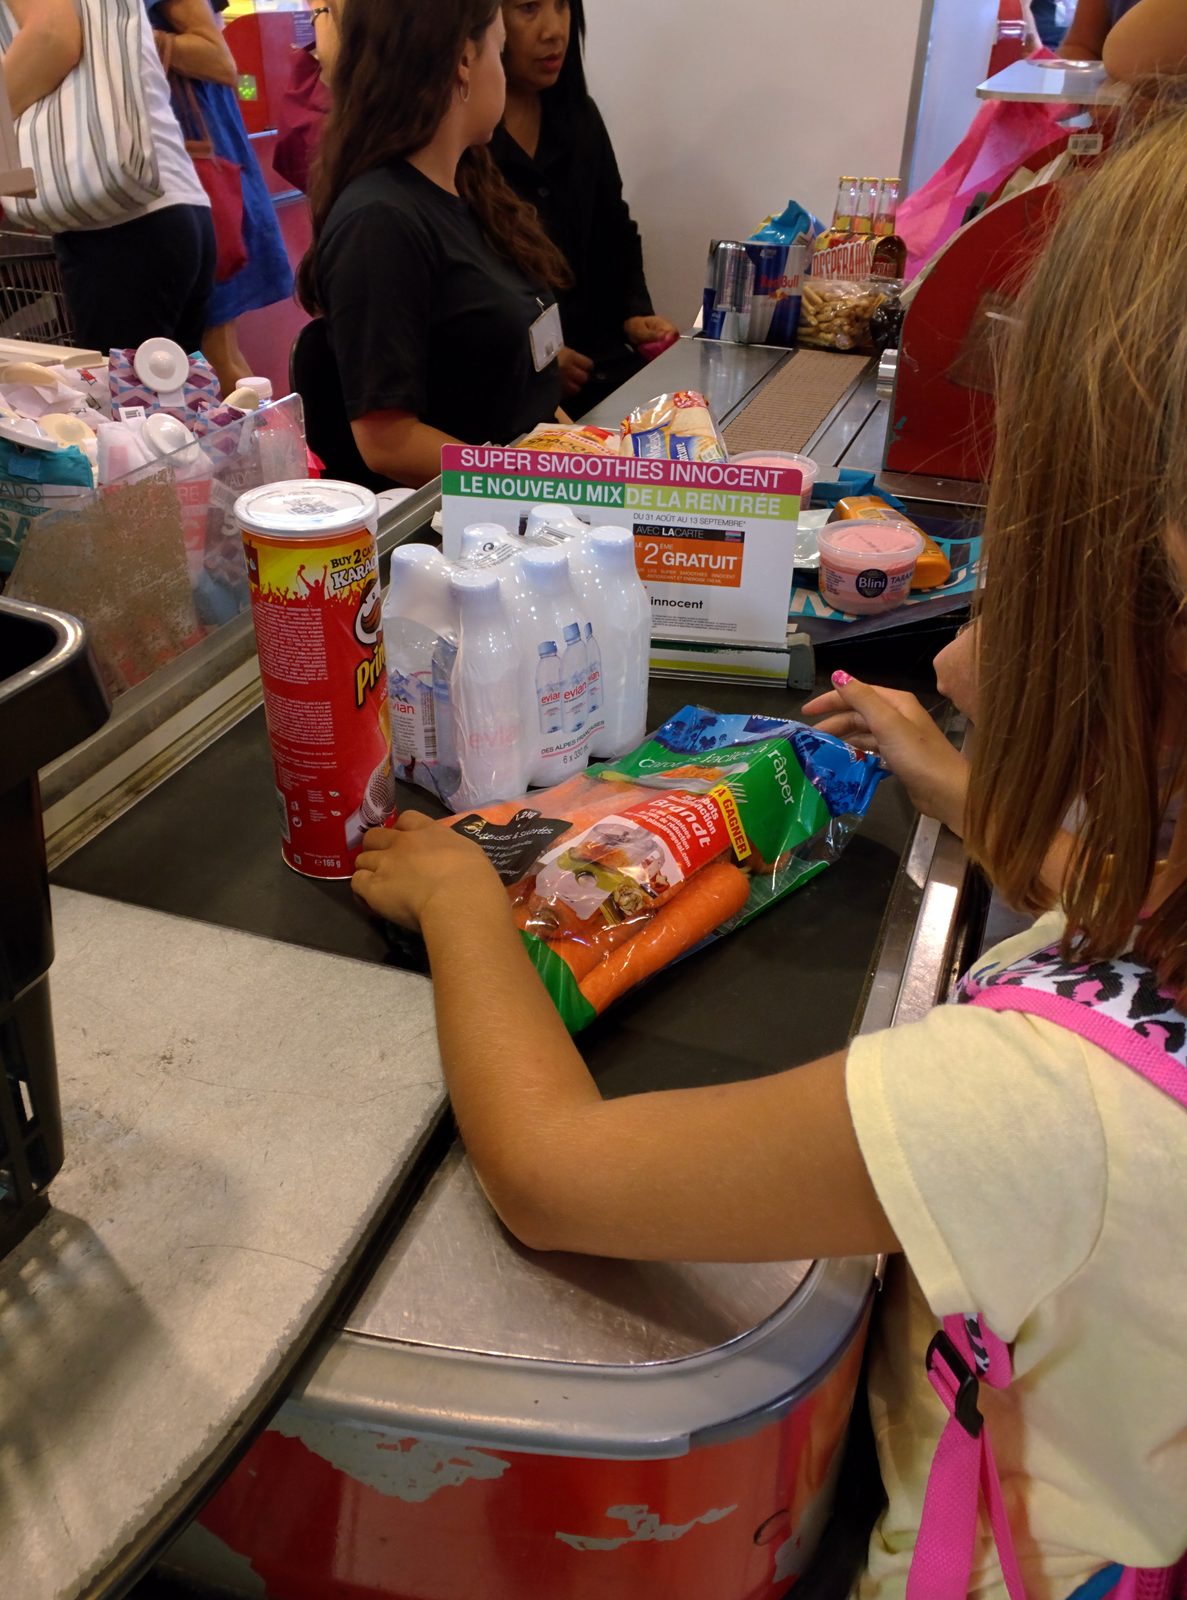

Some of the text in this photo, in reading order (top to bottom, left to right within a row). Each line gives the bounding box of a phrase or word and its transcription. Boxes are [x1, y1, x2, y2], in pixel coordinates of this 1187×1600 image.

[781, 274, 800, 288] Bull
[460, 448, 784, 489] SUPER SMOOTHIES INNOCENT
[460, 475, 780, 516] LE NOUVEAU MIX DE LA RENTRÉE
[633, 512, 645, 520] DU
[645, 513, 654, 521] 31
[655, 513, 676, 523] AOÛT
[677, 516, 688, 524] AU
[690, 516, 698, 525] 13
[636, 525, 705, 539] AVEC LACARTE
[330, 555, 352, 569] BUY
[353, 549, 362, 565] 2
[643, 543, 659, 565] 2
[662, 552, 737, 570] GRATUIT
[858, 577, 886, 588] Blini
[650, 596, 704, 609] innocent
[564, 682, 587, 700] evian
[393, 702, 415, 715] vian
[541, 746, 554, 755] DES
[555, 738, 577, 751] ALPES
[562, 755, 568, 764] 6
[767, 749, 795, 806] râper
[648, 799, 711, 848] Brandt
[722, 798, 747, 854] GAGNER
[667, 822, 690, 850] réduction
